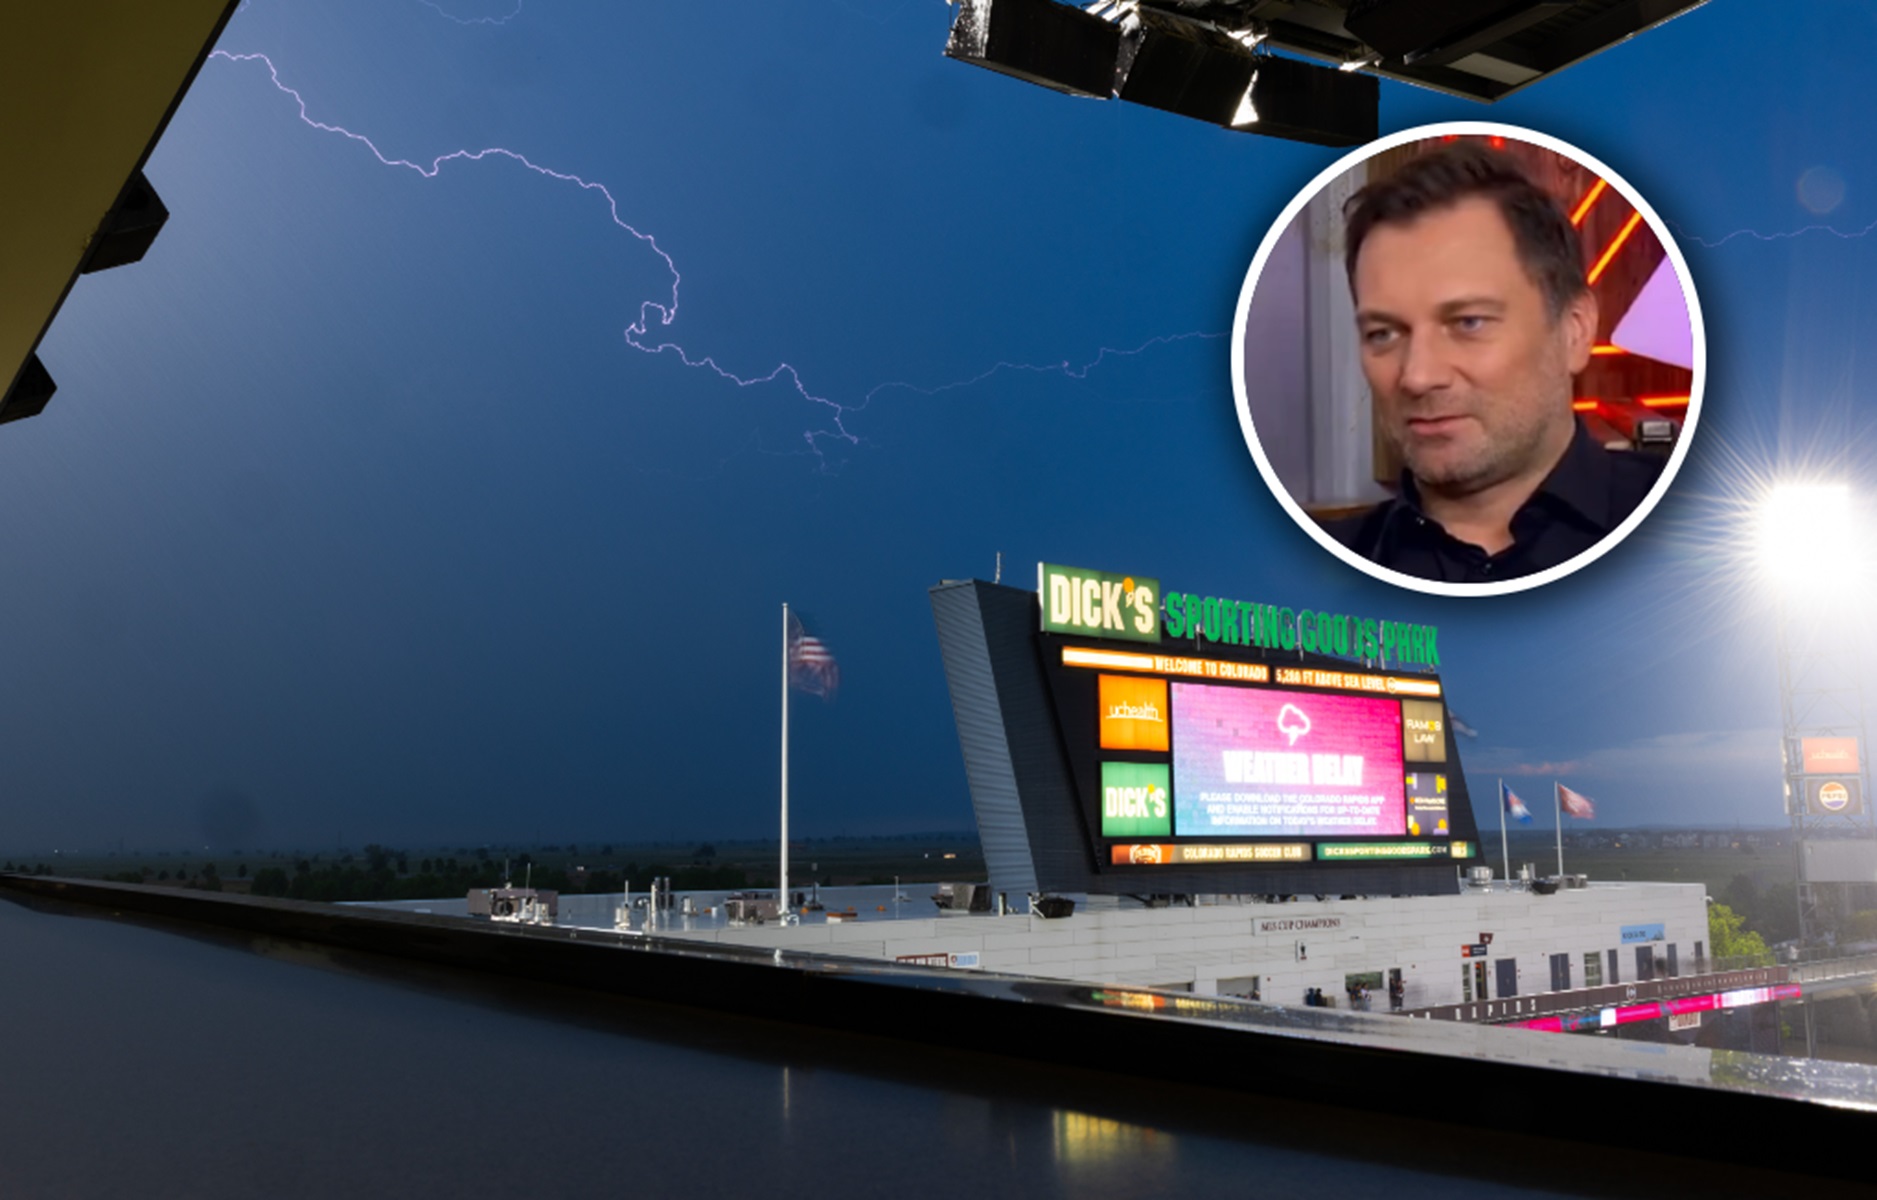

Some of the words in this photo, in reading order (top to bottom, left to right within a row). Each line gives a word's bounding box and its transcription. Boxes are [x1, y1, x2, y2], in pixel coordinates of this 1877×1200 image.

[1050, 573, 1154, 634] DICK'S
[1165, 591, 1295, 651] SPORTING
[1299, 608, 1379, 659] GOODS
[1381, 620, 1440, 666] PARK
[1155, 656, 1203, 675] WELCOME
[1205, 661, 1217, 676] TO
[1219, 662, 1267, 681] COLORADO
[1302, 671, 1313, 684] FT
[1315, 672, 1342, 688] ABOVE
[1343, 675, 1360, 688] SEA
[1361, 677, 1386, 691] LEVEL
[1109, 701, 1158, 720] uchealth
[1414, 734, 1435, 744] LAW
[1223, 750, 1310, 784] WEATHER
[1312, 755, 1363, 786] DELAY
[1105, 783, 1167, 818] DICK'S
[1200, 792, 1232, 802] PLEASE
[1234, 793, 1281, 803] DOWNLOAD
[1283, 794, 1297, 803] THE
[1299, 794, 1342, 803] COLORADO
[1343, 795, 1369, 804] RAPIDS
[1371, 796, 1385, 804] APP
[1207, 804, 1225, 814] AND
[1227, 804, 1259, 814] ENABLE
[1261, 804, 1318, 814] NOTIFICATIONS
[1320, 805, 1335, 814] FOR
[1337, 806, 1380, 815] UP-TO-DATE
[1211, 816, 1268, 825] INFORMATION
[1269, 816, 1281, 825] ON
[1283, 816, 1315, 825] TODAY'S
[1317, 816, 1352, 825] WEATHER
[1183, 847, 1224, 860] COLORADO
[1225, 847, 1253, 859] RAPIDS
[1254, 846, 1282, 858] SOCCER
[1284, 846, 1302, 858] CLUB
[1278, 920, 1294, 930] CUP
[1295, 918, 1341, 930] CHAMPIONS
